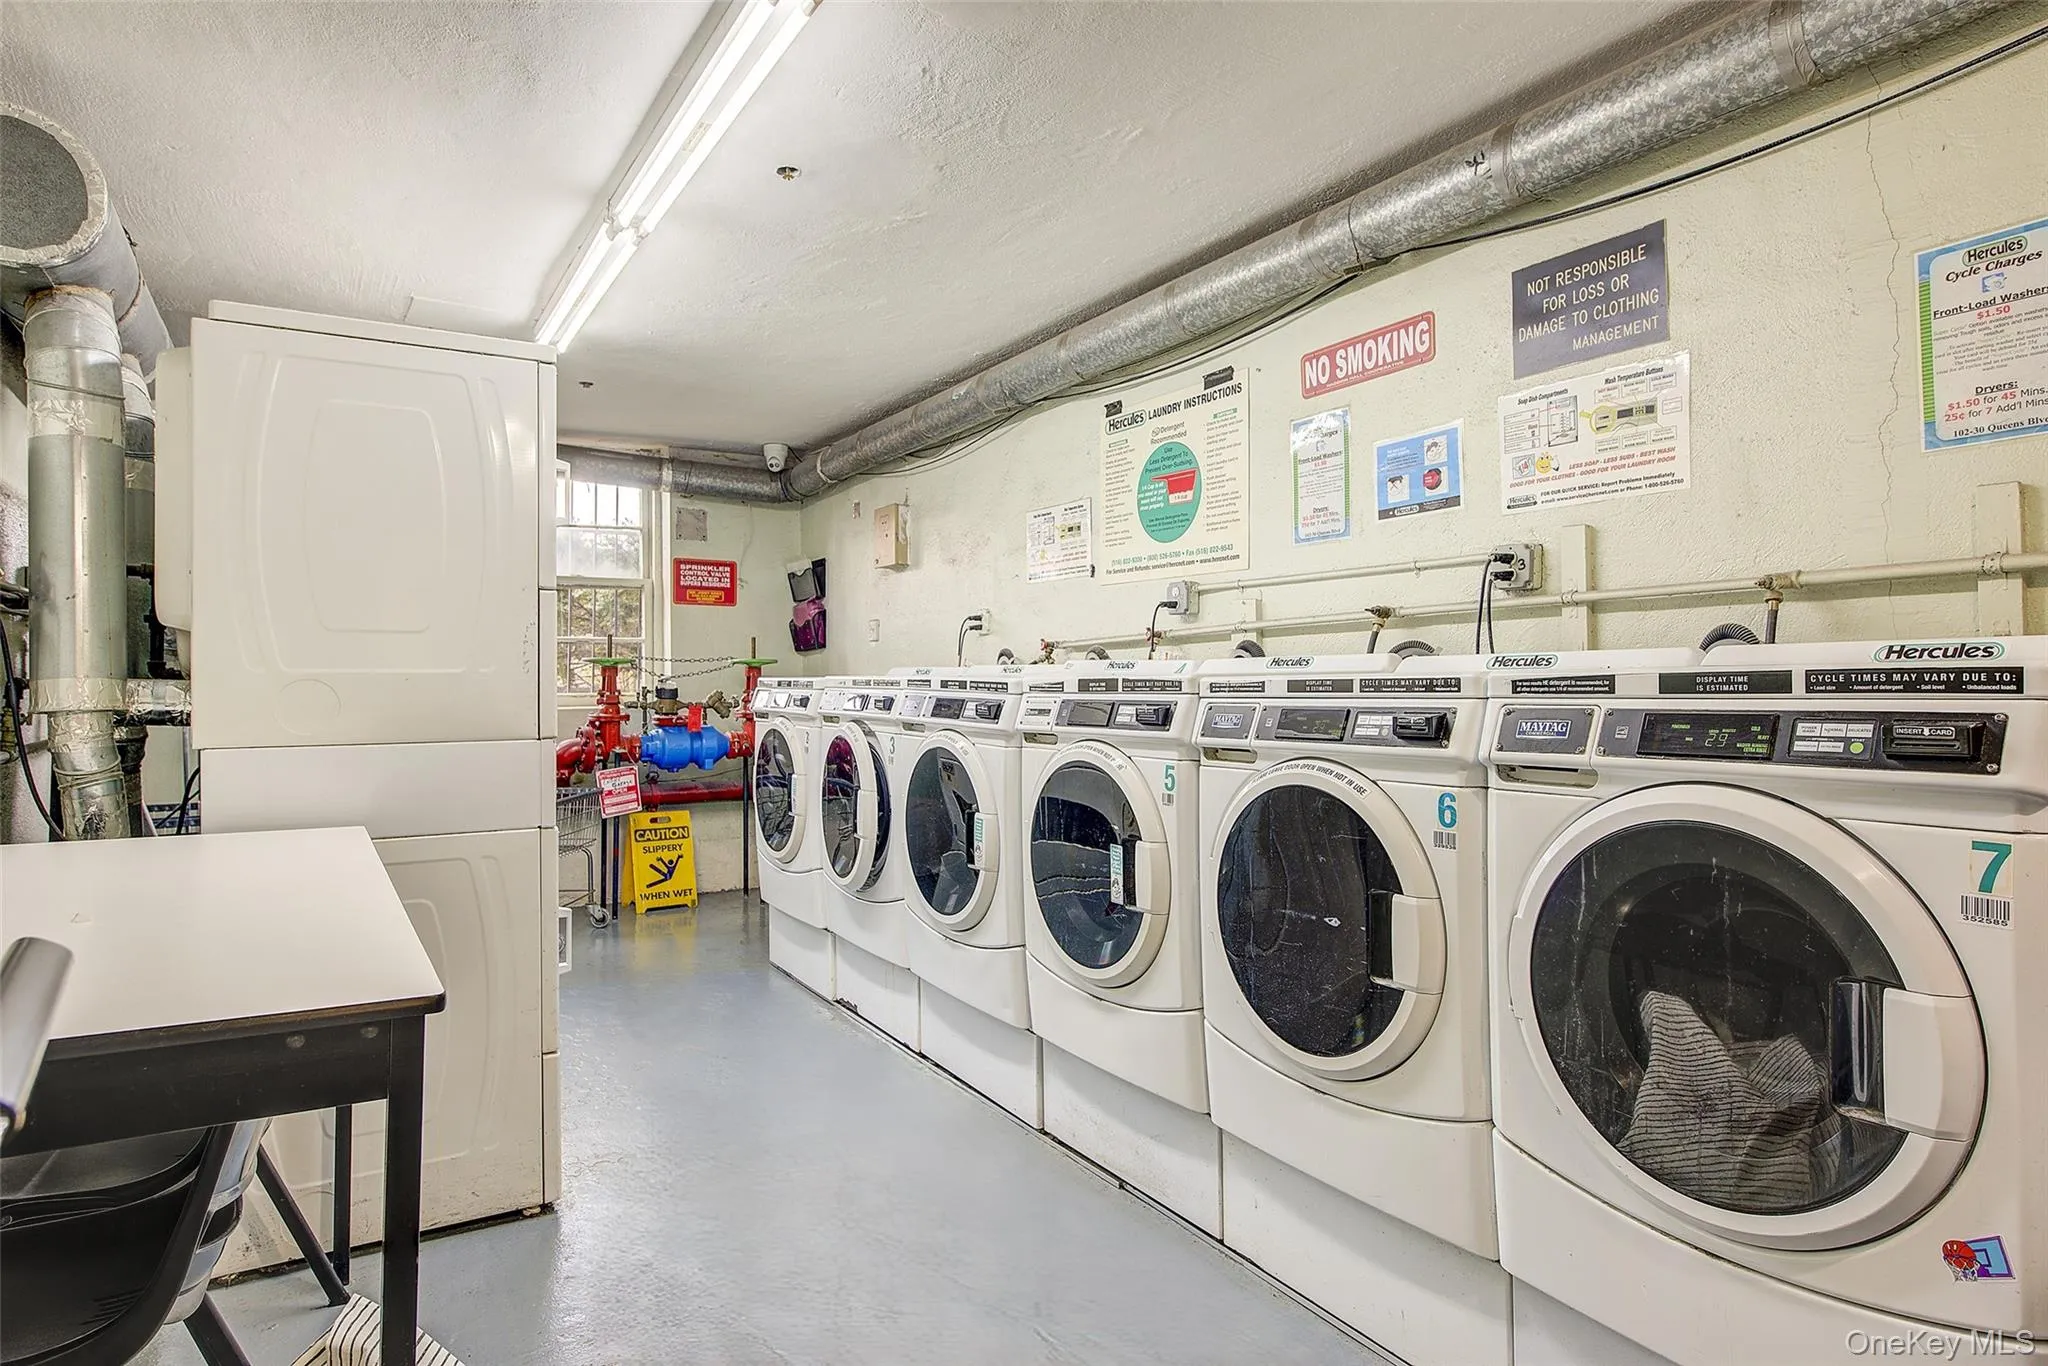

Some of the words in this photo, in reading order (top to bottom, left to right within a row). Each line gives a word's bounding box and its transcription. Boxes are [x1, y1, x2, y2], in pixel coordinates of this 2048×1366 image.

[1967, 239, 2023, 263] Hercules
[1527, 276, 1551, 297] NOT
[1556, 243, 1647, 288] RESPONSIBLE
[1945, 266, 1981, 283] Cycle
[1985, 250, 2043, 272] Charges
[1543, 294, 1566, 314] FOR
[1572, 281, 1605, 305] LOSS
[1610, 273, 1630, 293] OR
[1518, 316, 1566, 343] DAMAGE
[1572, 310, 1588, 327] TO
[1593, 288, 1659, 320] CLOTHING
[1933, 297, 1997, 319] Front-Load
[1977, 305, 2011, 320] $1.50
[1572, 315, 1659, 351] MANAGEMENT
[1305, 355, 1331, 389] NO
[1335, 320, 1430, 379] SMOKING
[1975, 380, 2019, 396] Dryers:
[1108, 412, 1145, 432] Hercules
[1148, 401, 1183, 420] LAUNDRY
[1183, 382, 1243, 410] INSTRUCTIONS
[1948, 397, 1980, 412] $1.50
[1983, 395, 1998, 404] for
[2001, 391, 2017, 401] 45
[1944, 413, 1965, 422] 25¢
[1968, 409, 1983, 418] for
[1985, 407, 1993, 415] 7
[1954, 425, 1985, 437] 102-30
[1987, 420, 2025, 433] Queens
[1569, 462, 1583, 470] LESS
[1603, 456, 1618, 464] LESS
[1619, 453, 1635, 461] SUDS
[1640, 449, 1656, 458] BEST
[1627, 459, 1656, 468] LAUNDRY
[680, 564, 730, 572] SPRINKLER
[1517, 558, 1526, 571] 3
[1884, 642, 1995, 660] Hercules
[1269, 657, 1311, 667] Hercules
[1491, 655, 1553, 667] Hercules
[1696, 675, 1727, 683] DISPLAY
[1730, 675, 1749, 683] TIME
[1810, 674, 1846, 683] CYCLE
[1850, 673, 1887, 682] TIMES
[1892, 673, 1918, 682] MAY
[1924, 673, 1956, 682] VARY
[1962, 672, 1988, 682] DUE
[1994, 672, 2017, 682] TO:
[1706, 684, 1749, 692] ESTIMATED
[1520, 721, 1567, 732] MAYTAG
[1930, 728, 1953, 736] CARD
[889, 736, 896, 754] 3
[1704, 733, 1728, 747] 29
[1164, 764, 1176, 792] 5
[1315, 764, 1333, 776] WHEN
[1333, 770, 1347, 782] NOT
[1345, 779, 1355, 787] IN
[1352, 784, 1367, 796] USE
[1438, 792, 1457, 829] 6
[636, 827, 688, 841] CAUTION
[643, 843, 684, 855] SLIPPERY
[1971, 840, 2012, 894] 7
[640, 890, 670, 901] WHEN
[672, 888, 693, 898] WET
[1962, 914, 2009, 927] 352585
